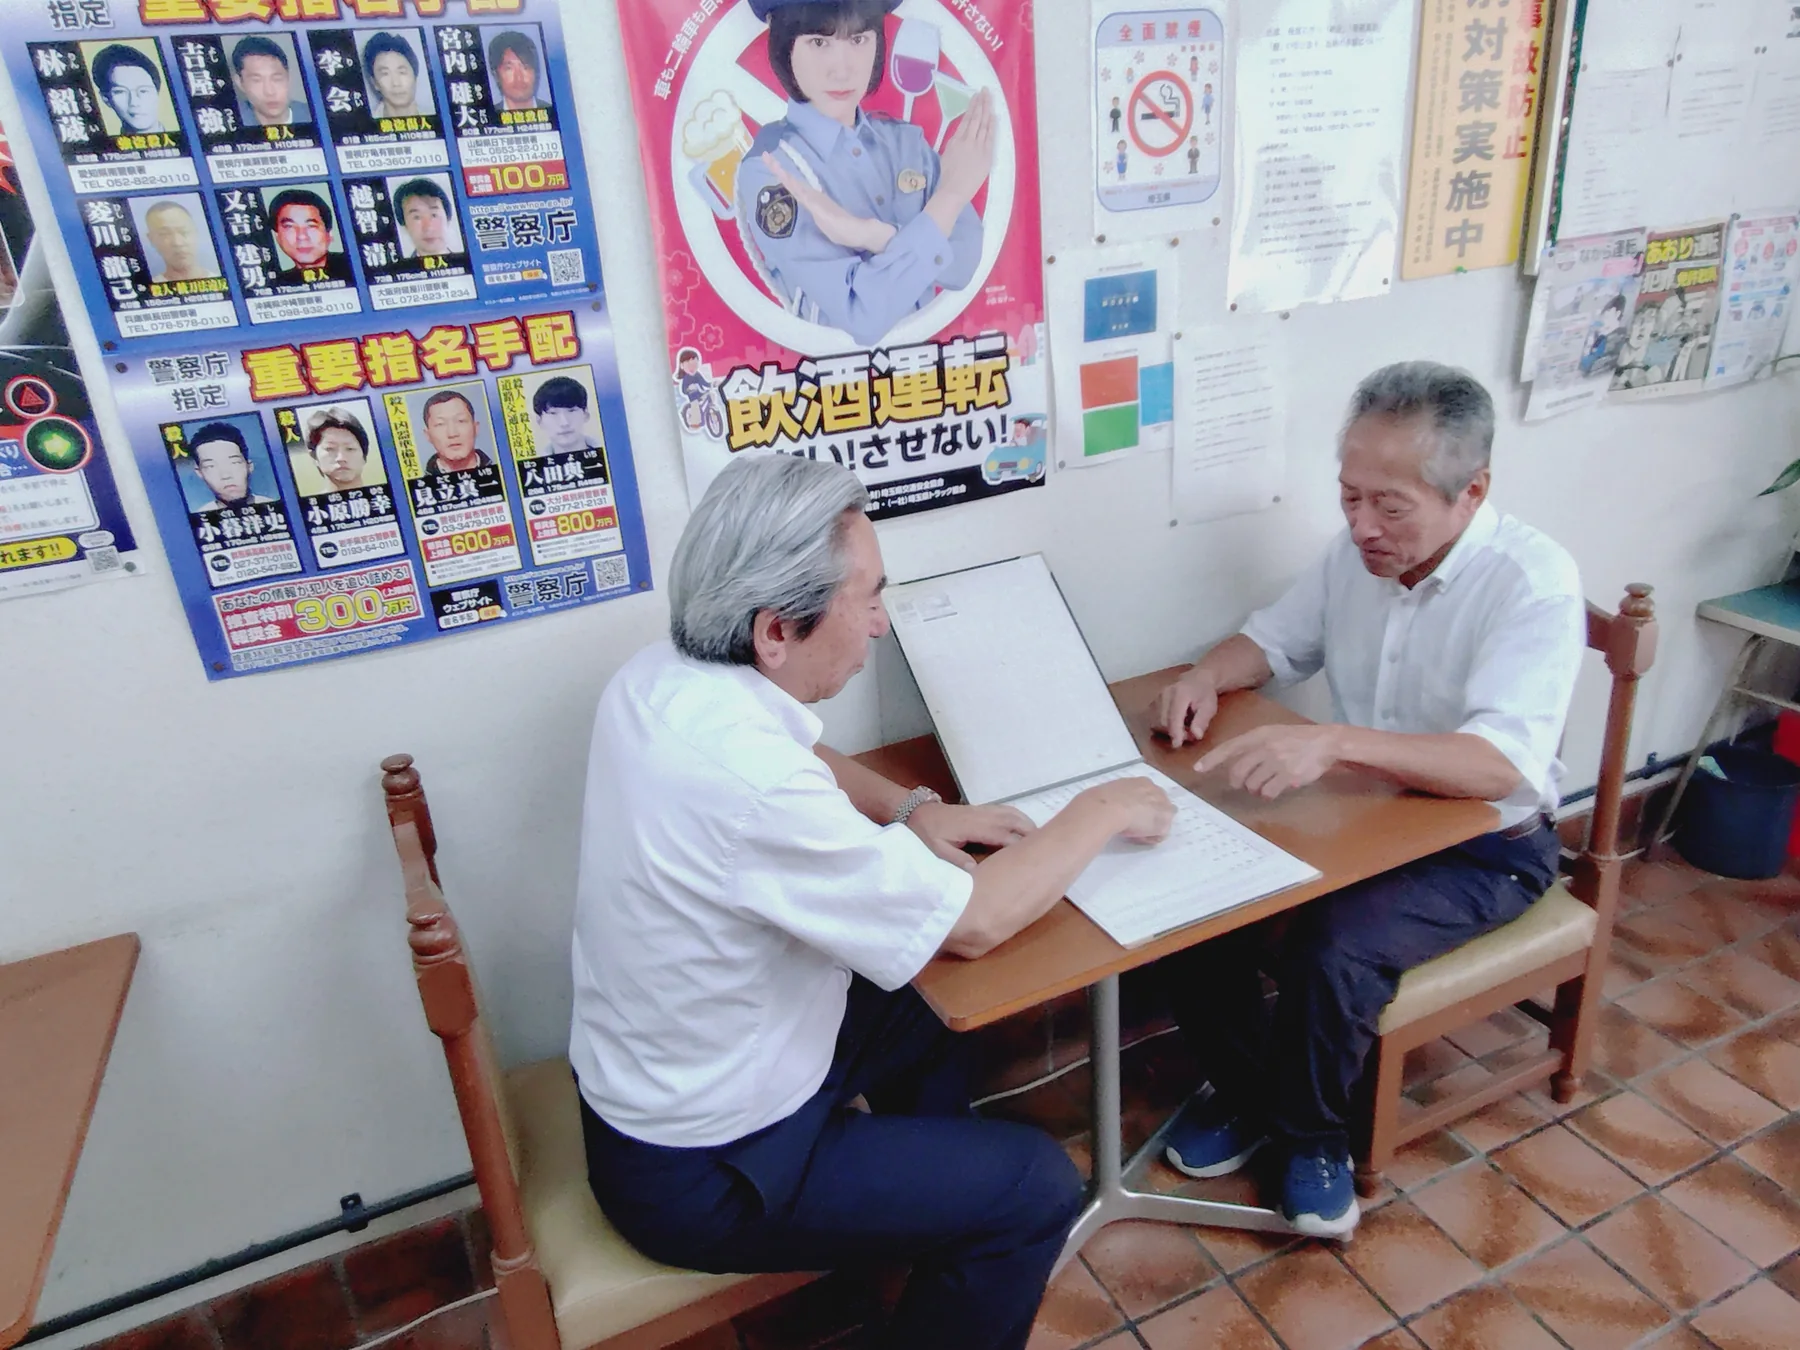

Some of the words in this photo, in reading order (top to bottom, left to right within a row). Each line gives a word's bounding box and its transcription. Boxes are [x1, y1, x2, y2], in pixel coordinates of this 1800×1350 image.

[51, 0, 111, 29] 指定
[1118, 19, 1202, 42] 全面禁煙
[438, 26, 468, 74] 宮内
[653, 0, 725, 101] 車も二輪車も自
[1445, 0, 1510, 259] 対策実施中
[347, 160, 366, 170] TEL
[368, 153, 442, 168] 03-3607-0110
[469, 147, 486, 157] TEL
[81, 179, 104, 190] TEL
[218, 169, 240, 180] TEL
[241, 163, 321, 178] 03-3620-0110
[221, 189, 251, 236] 又吉
[473, 209, 577, 251] 警察庁
[379, 297, 398, 307] TEL
[399, 289, 471, 305] 072-823-1234
[127, 324, 149, 335] TEL
[256, 311, 277, 320] TEL
[148, 352, 230, 384] 警察庁
[243, 312, 579, 402] 重要指名手配
[171, 384, 226, 412] 指定
[719, 332, 1013, 453] 飲酒運転
[501, 379, 525, 458] 道路交通法違反
[513, 377, 537, 457] 殺人・殺人未遂
[415, 478, 500, 509] 見立真一
[546, 487, 608, 506] 大分県別府警察署
[547, 497, 608, 514] 0977-21-2131
[307, 494, 392, 526] 小原勝幸
[439, 506, 505, 526] 警視庁麻布警察署
[556, 511, 614, 536] 800万円
[199, 511, 288, 543] 小暮洋史
[338, 529, 398, 548] 岩手県宮古警察署
[442, 515, 507, 534] 03-3479-0110
[450, 529, 511, 555] 600万円
[221, 570, 409, 612] あなたの情報が犯人を追い詰める!
[507, 571, 589, 608] 警察庁
[294, 587, 417, 633] 300万円
[442, 596, 493, 613] ウェブサイト
